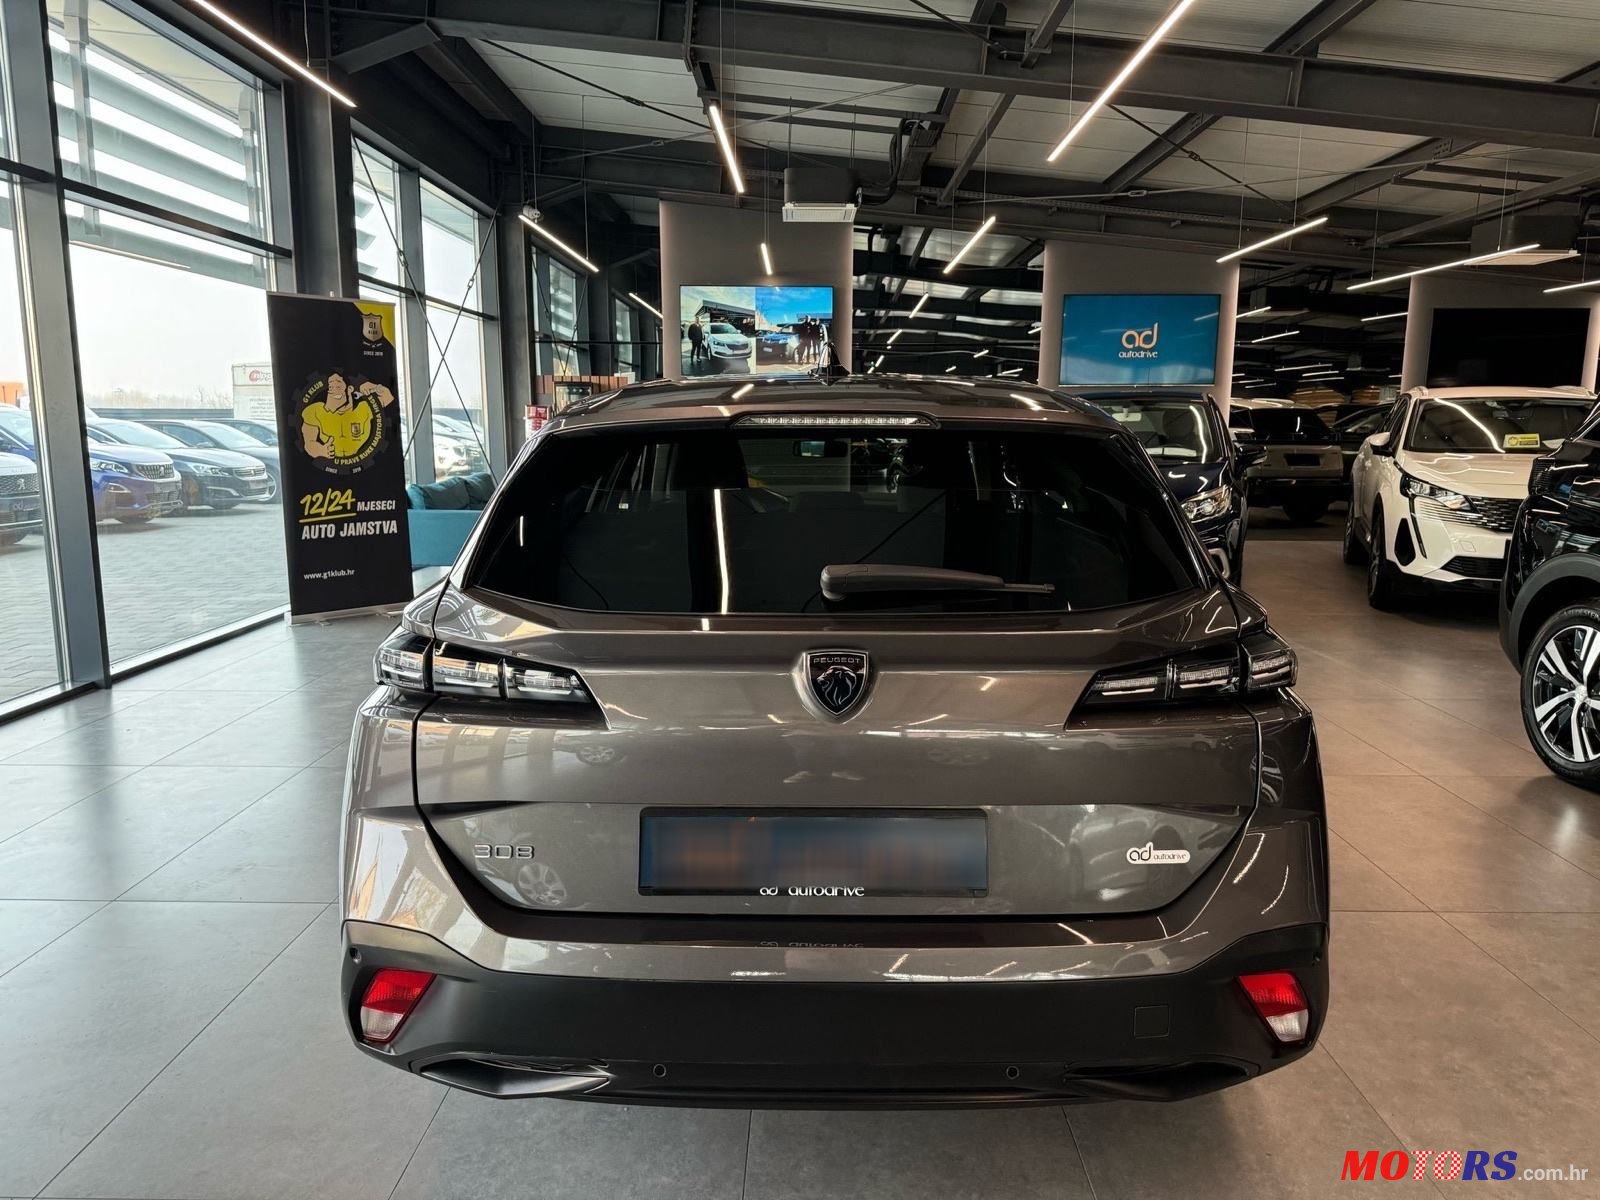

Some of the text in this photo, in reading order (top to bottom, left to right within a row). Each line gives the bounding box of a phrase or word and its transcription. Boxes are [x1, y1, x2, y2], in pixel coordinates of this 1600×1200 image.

[1121, 322, 1159, 349] ad
[1118, 350, 1158, 359] autodrive
[307, 381, 324, 396] KLUB
[341, 456, 361, 465] PRAVE
[359, 445, 375, 460] RUKE
[299, 488, 396, 516] 12/24 MJESECI
[301, 520, 398, 540] AUTO JAMSTVA
[303, 569, 355, 580] www.g1klub.hr
[813, 656, 861, 664] PEUGEOT
[473, 844, 534, 859] 308
[1129, 845, 1152, 861] ad
[759, 885, 865, 897] ad autodrive
